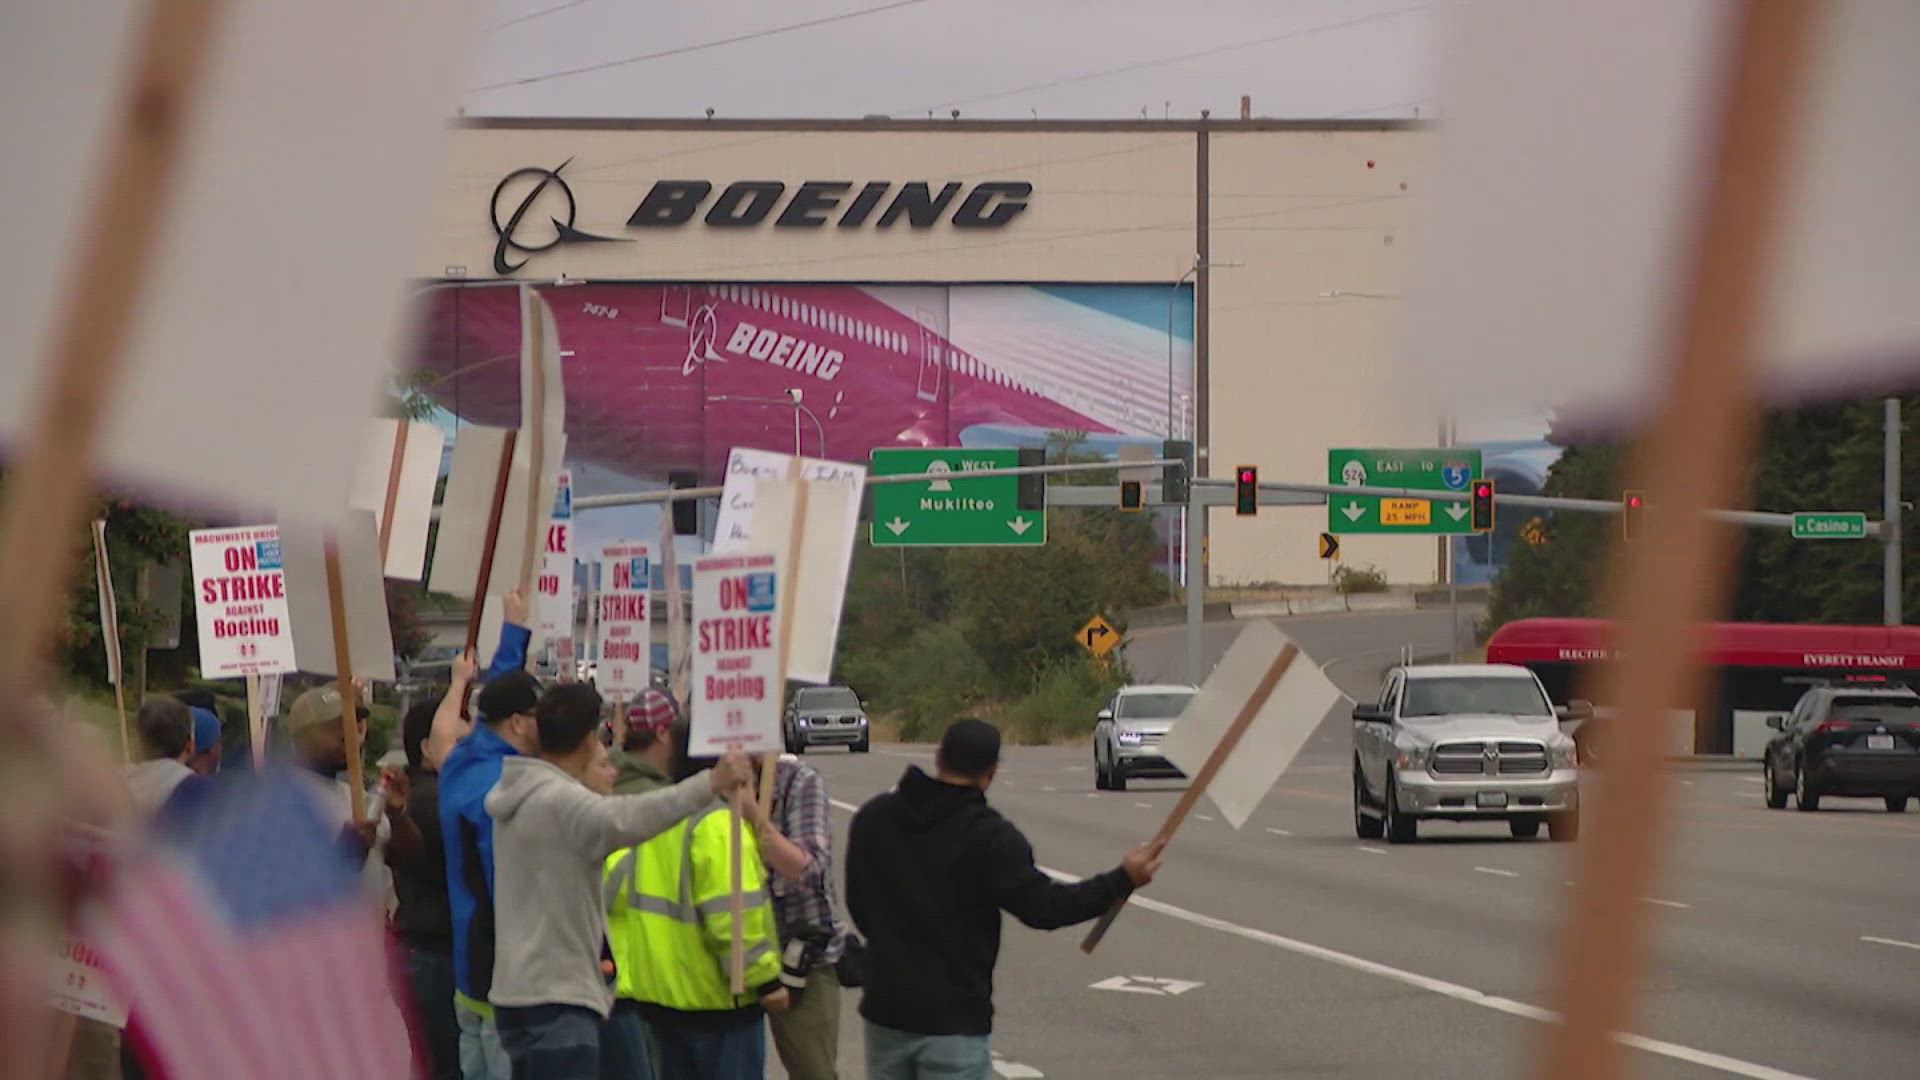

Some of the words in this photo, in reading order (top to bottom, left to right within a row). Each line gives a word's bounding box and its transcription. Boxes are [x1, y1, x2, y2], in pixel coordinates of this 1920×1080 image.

[626, 181, 1033, 227] BOEING
[726, 322, 844, 381] BOEING
[961, 459, 995, 471] WEST
[1377, 460, 1404, 472] EAST
[1421, 460, 1434, 472] TO
[1451, 467, 1463, 485] 5
[920, 498, 995, 511] Mukilteo
[1391, 499, 1419, 509] RAMP
[1386, 512, 1398, 522] 25
[1404, 512, 1426, 522] MPH
[1807, 518, 1849, 532] Casino
[224, 545, 256, 571] ON
[613, 562, 630, 589] ON
[202, 573, 284, 604] STRIKE
[719, 576, 748, 611] ON
[225, 603, 264, 616] AGAINST
[602, 594, 645, 622] STRIKE
[214, 618, 279, 638] Boeing
[698, 615, 772, 653] STRIKE
[604, 639, 640, 662] Boeing
[1803, 653, 1854, 666] EVERETT
[1855, 655, 1905, 667] TRANSIT
[705, 673, 765, 701] Boeing
